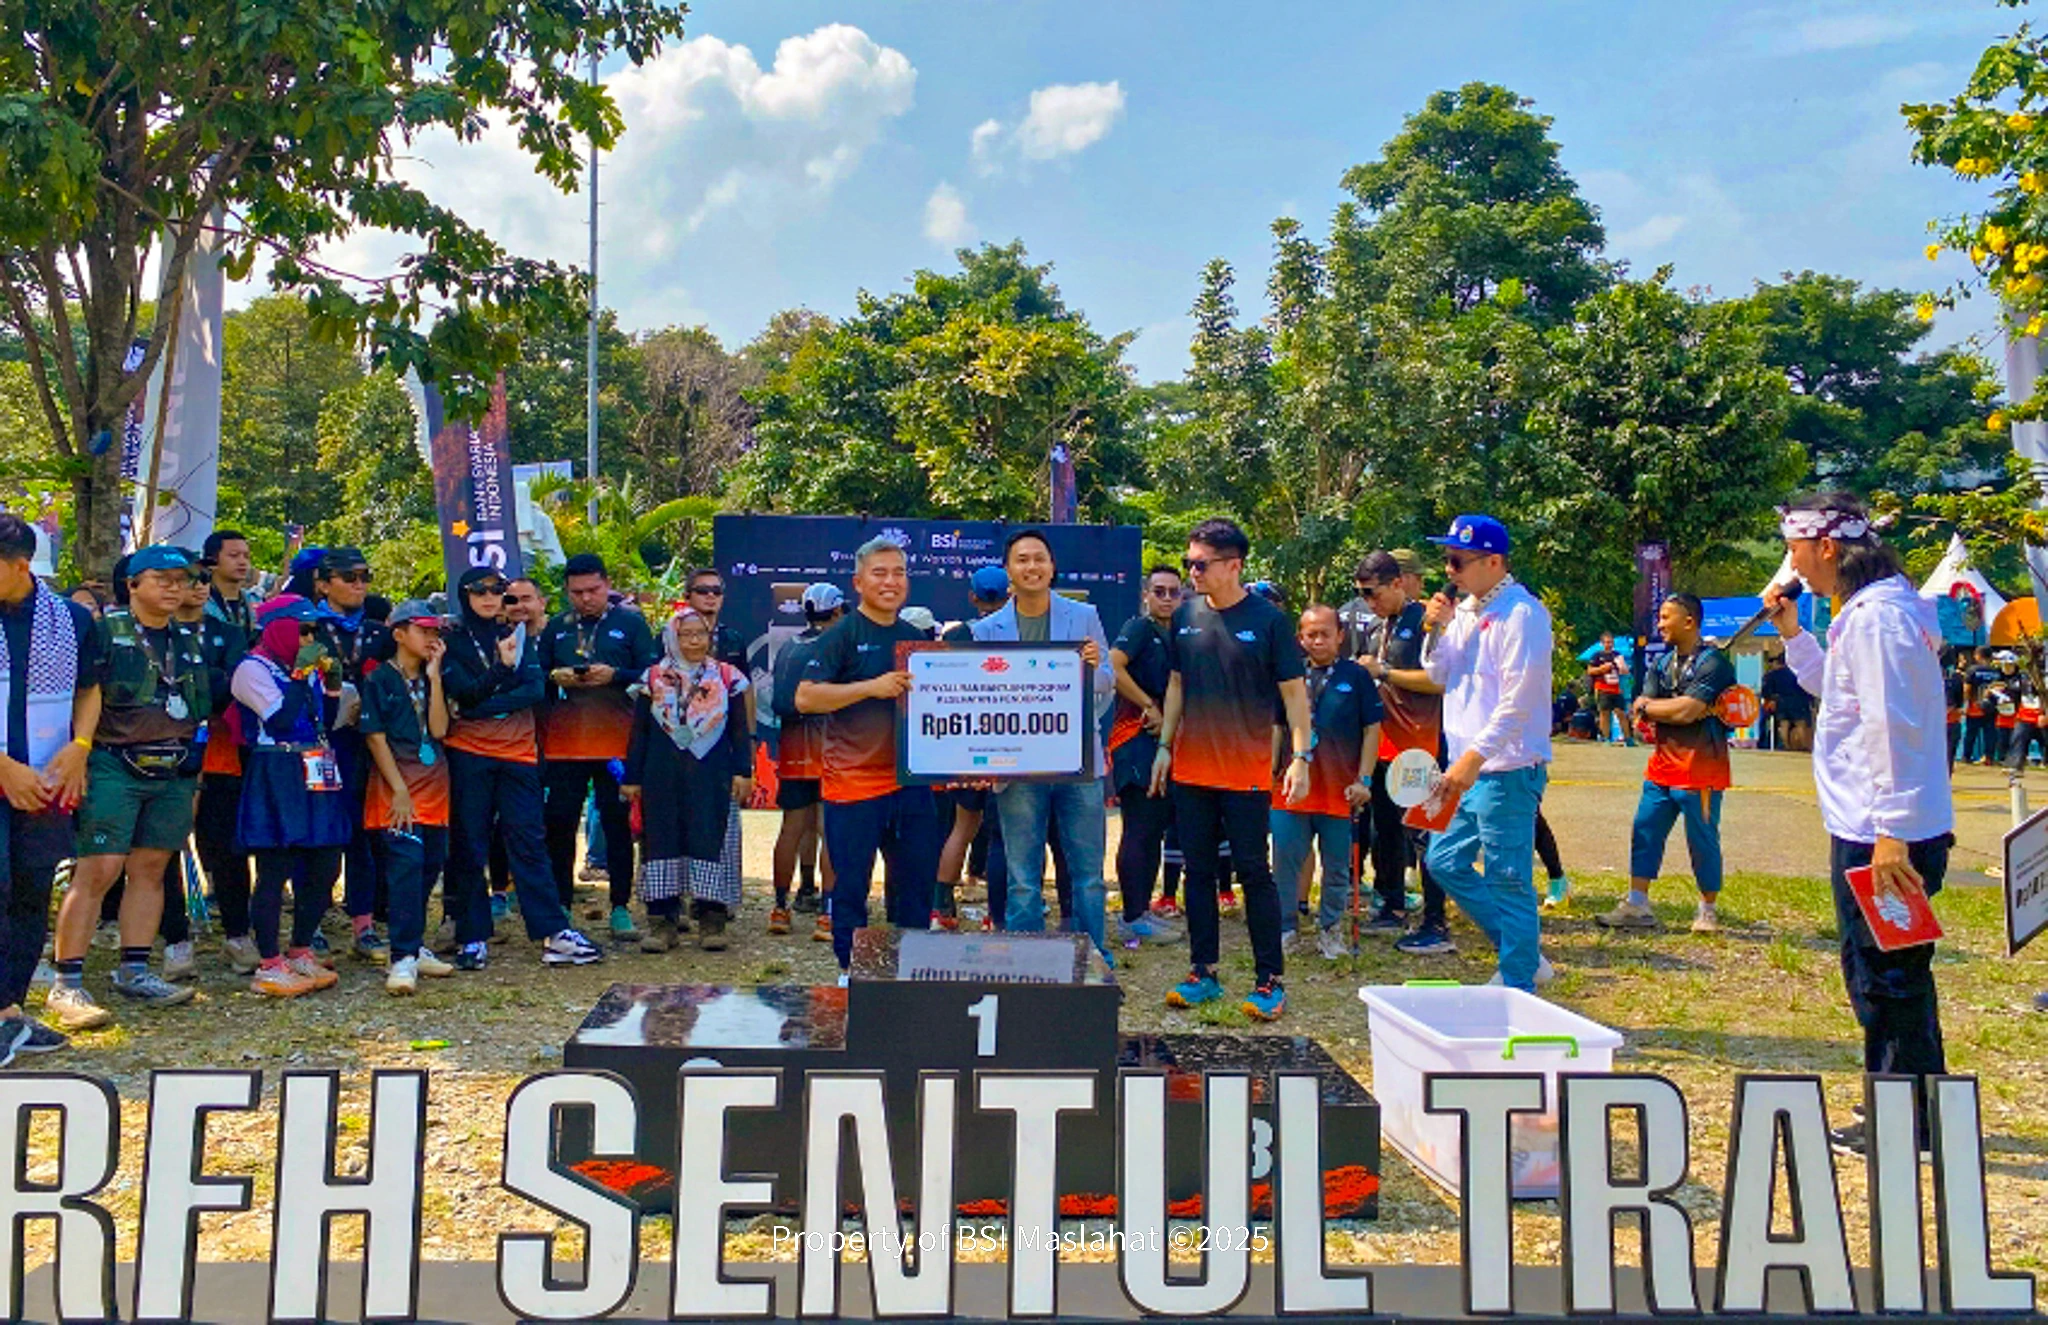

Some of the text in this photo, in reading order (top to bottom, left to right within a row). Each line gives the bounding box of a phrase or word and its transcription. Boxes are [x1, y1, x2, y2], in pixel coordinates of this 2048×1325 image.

[469, 424, 485, 478] SYARIA
[483, 442, 501, 521] INDONESIA
[931, 533, 958, 549] BSI
[921, 713, 1068, 739] Rp61.900.000
[968, 995, 998, 1056] 1
[0, 1070, 2036, 1322] RFH SENTUL TRAIL
